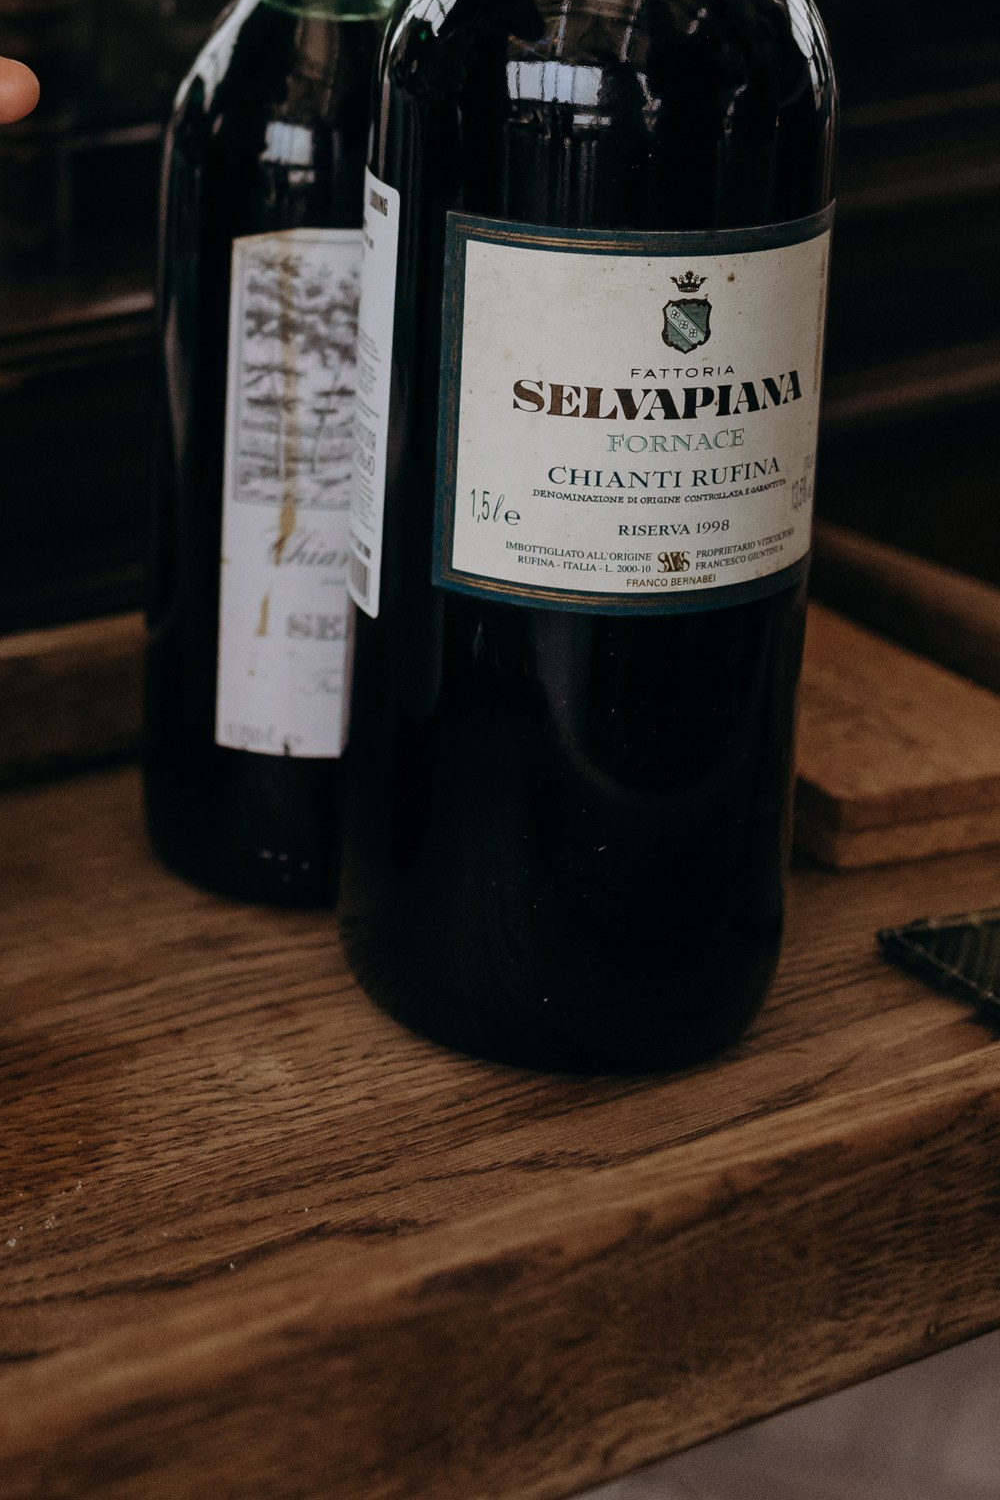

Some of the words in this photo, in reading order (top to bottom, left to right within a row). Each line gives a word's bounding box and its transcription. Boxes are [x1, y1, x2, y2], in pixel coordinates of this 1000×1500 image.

[630, 364, 735, 380] FATTORIA
[512, 369, 803, 421] SELVAPIANA
[606, 427, 746, 454] FORNACE
[547, 465, 682, 489] CHIANTI
[691, 456, 781, 488] RUFINA
[470, 488, 491, 524] 1,5
[532, 488, 625, 504] DENOMINAZIONE
[627, 495, 638, 504] DI
[640, 495, 682, 505] ORIGINE
[684, 489, 744, 504] CONTROLLATA
[617, 522, 691, 537] RISERVA
[694, 518, 731, 536] 1998
[505, 540, 585, 559] IMBOTTIGLIATO
[586, 550, 653, 562] ALL'ORIGINE
[696, 540, 756, 559] PROPRIETARIO
[517, 554, 555, 569] RUFINA
[563, 561, 597, 573] ITALIA
[616, 565, 652, 574] 2000-10
[695, 554, 747, 571] FRANCESCO
[626, 578, 668, 588] FRANCO
[670, 574, 717, 587] BERNABEI
